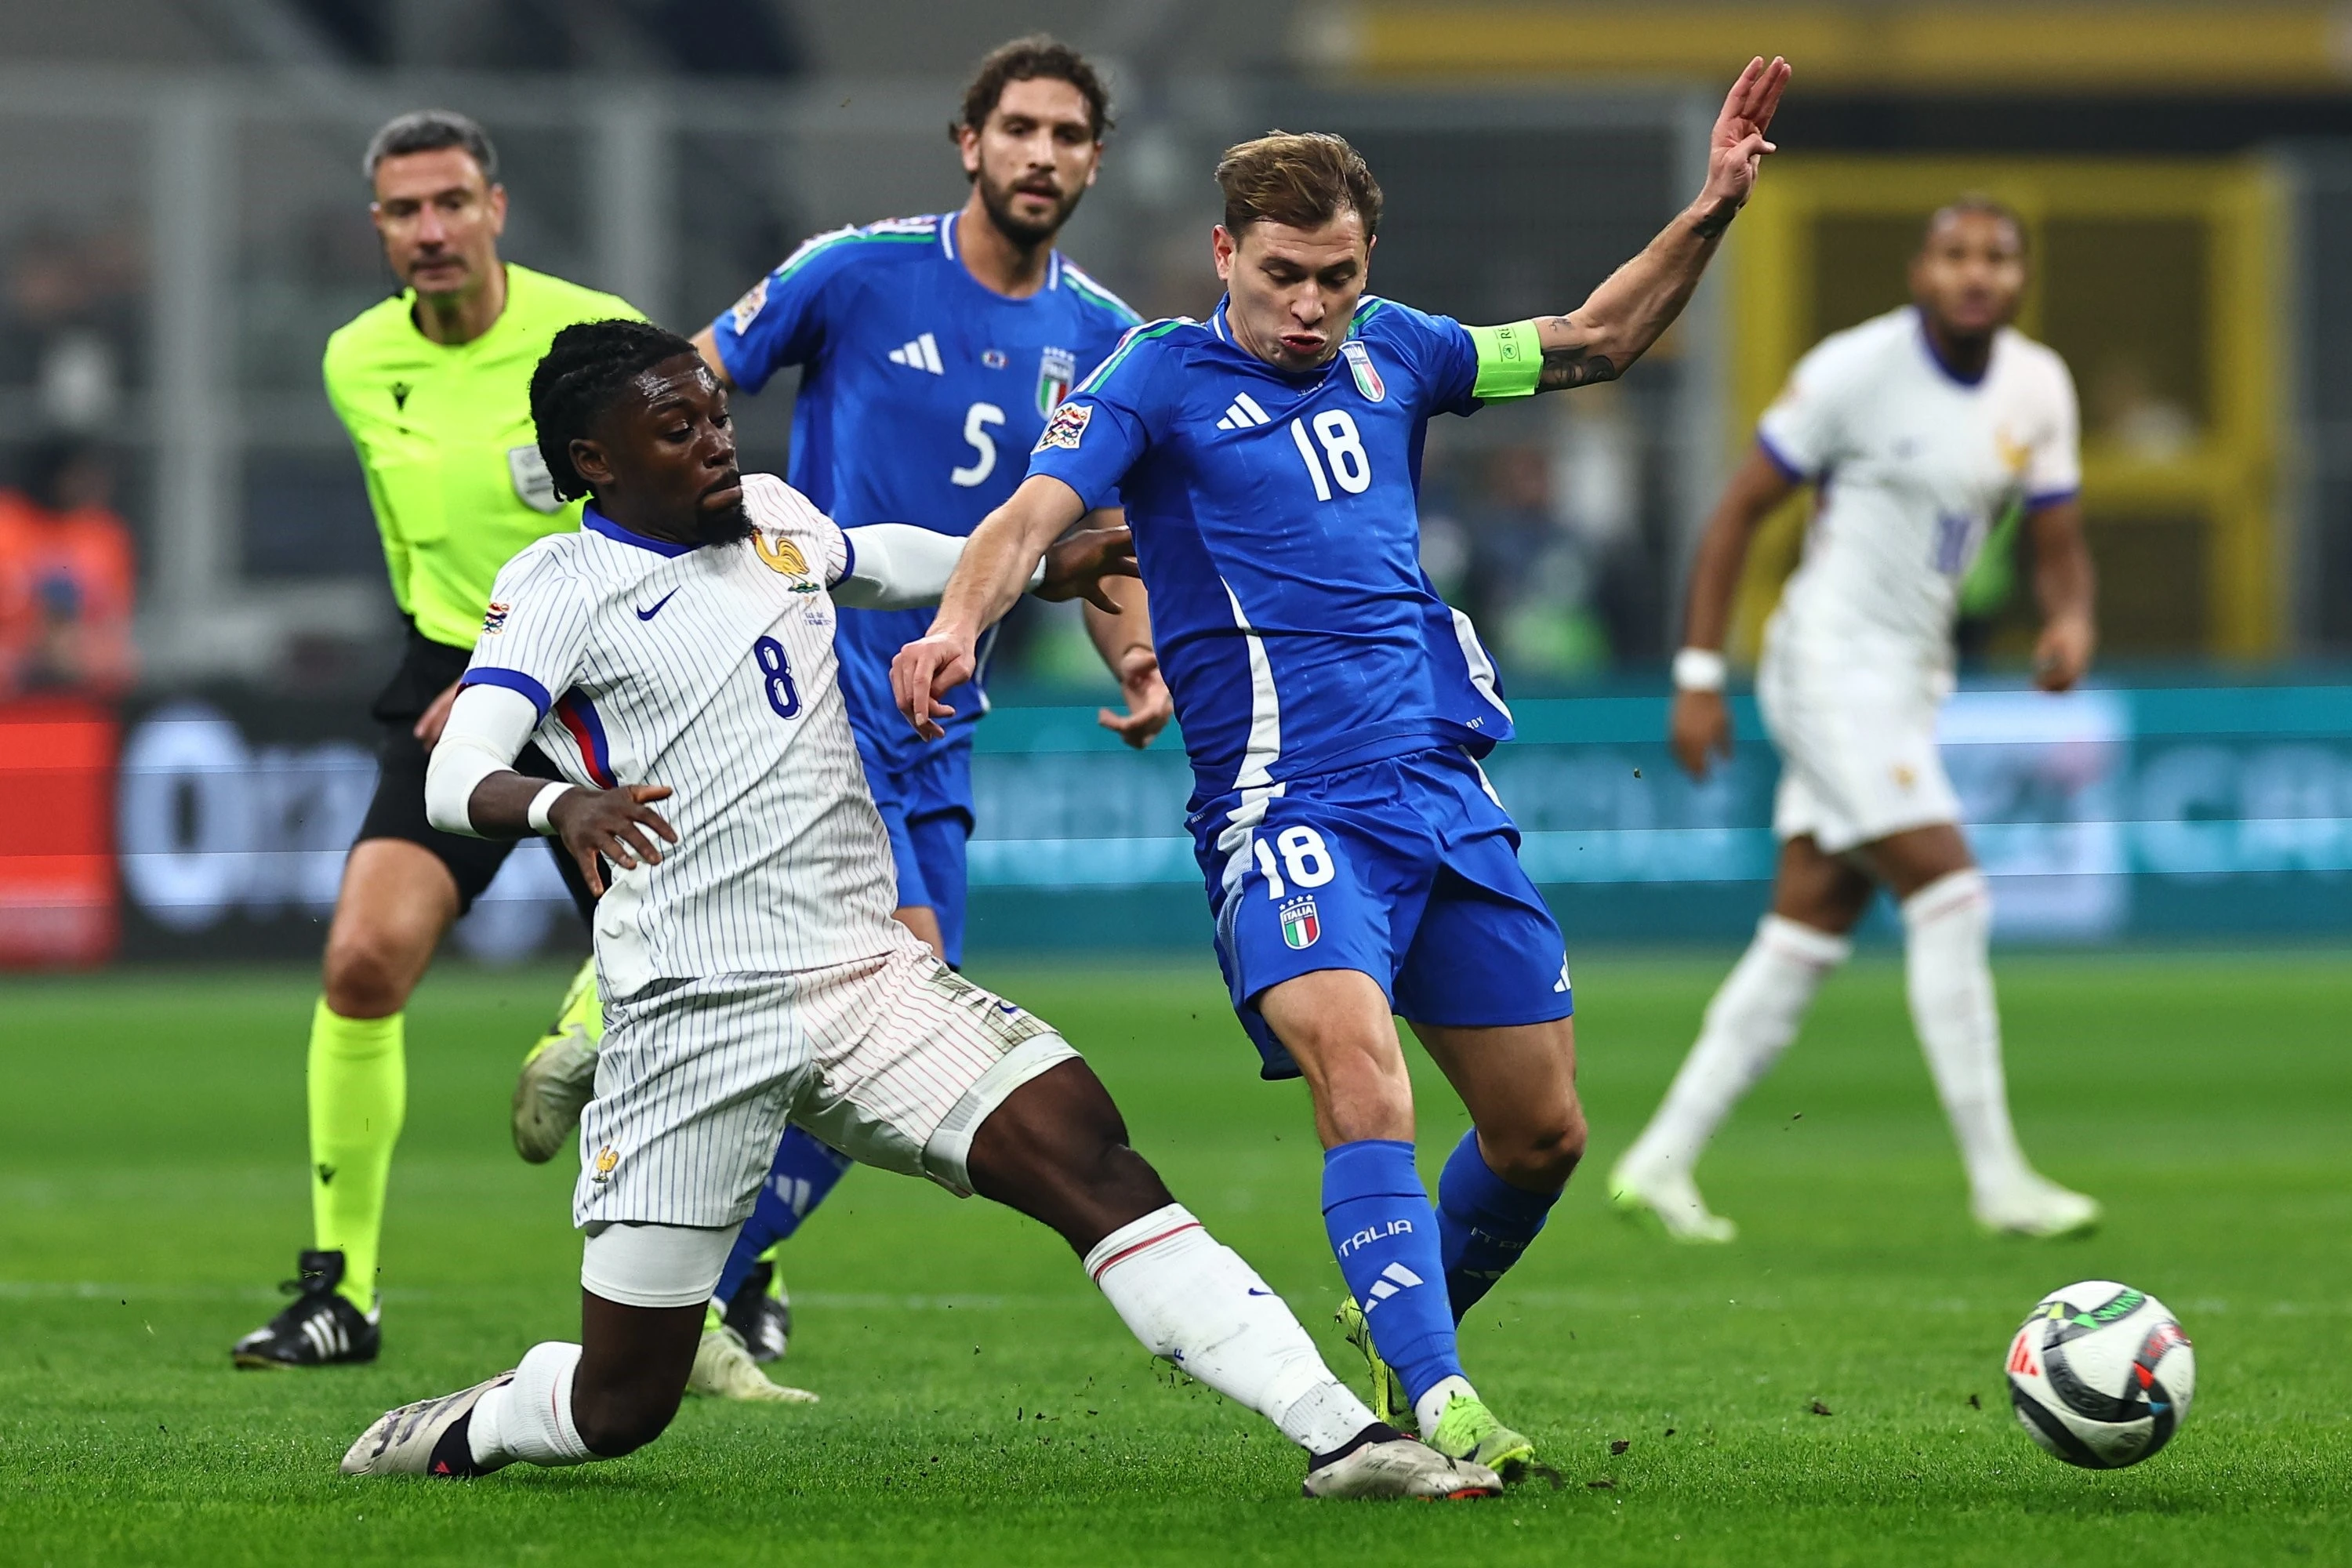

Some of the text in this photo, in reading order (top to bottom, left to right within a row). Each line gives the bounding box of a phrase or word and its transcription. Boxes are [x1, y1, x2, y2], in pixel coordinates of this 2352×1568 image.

[950, 401, 1007, 488] 5
[1290, 408, 1372, 502] 18
[753, 635, 803, 720] 8
[1254, 826, 1336, 901] 18
[1283, 905, 1313, 922] ITALIA
